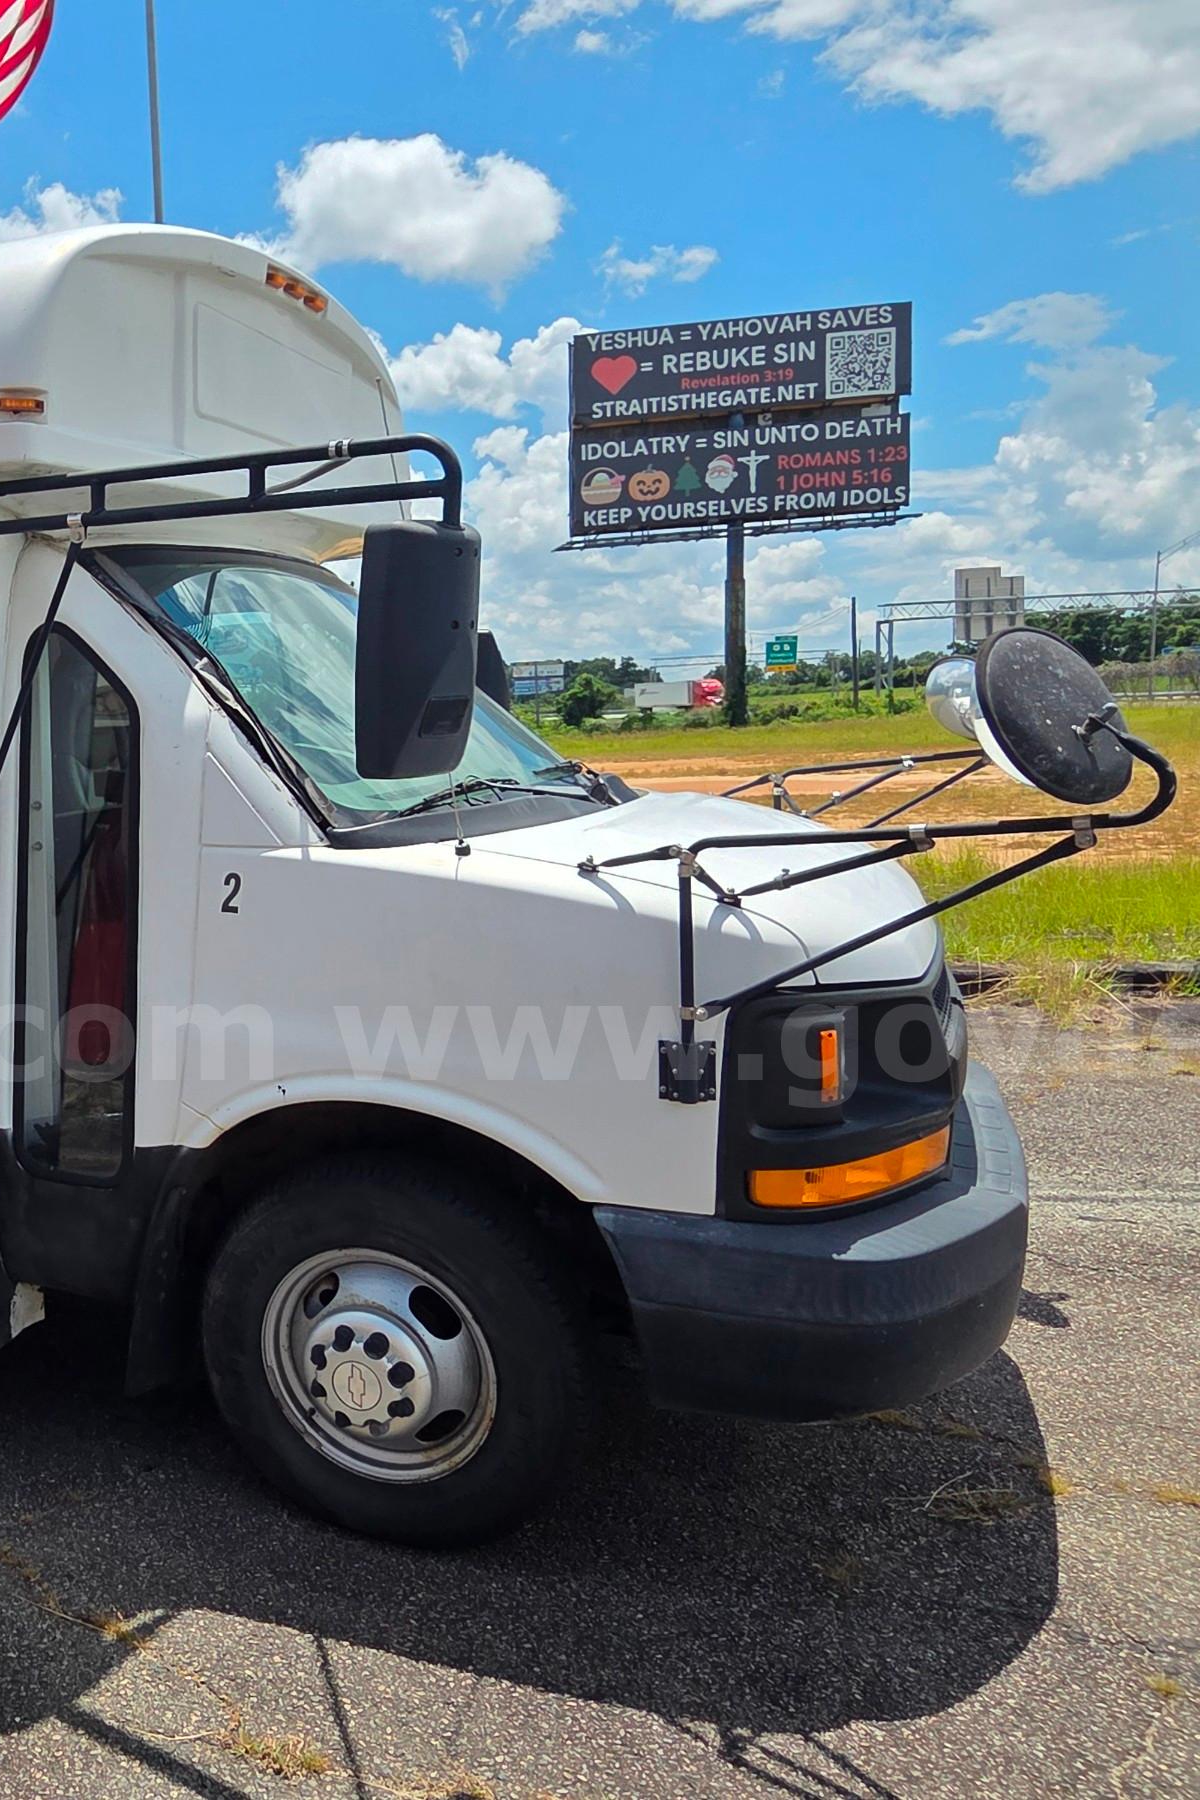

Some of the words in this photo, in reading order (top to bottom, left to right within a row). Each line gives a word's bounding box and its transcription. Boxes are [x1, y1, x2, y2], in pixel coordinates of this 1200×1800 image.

[587, 328, 674, 352] YESHUA
[680, 330, 692, 341] =
[698, 313, 811, 341] YAHOVAH
[818, 306, 892, 329] SAVES
[640, 362, 653, 372] =
[662, 345, 766, 374] REBUKE
[773, 340, 815, 364] SIN
[681, 371, 759, 389] Revelation
[763, 368, 794, 382] 3:19
[592, 382, 818, 419] STRAITISTHEGATE.NET
[581, 435, 690, 461] IDOLATRY
[696, 438, 708, 448] =
[713, 429, 748, 449] SIN
[755, 424, 819, 445] UNTO
[825, 416, 901, 439] DEATH
[777, 448, 861, 469] ROMANS
[867, 445, 908, 463] 1:23
[776, 475, 785, 490] 1
[790, 471, 845, 492] JOHN
[852, 467, 892, 485] 5:16
[583, 507, 632, 527] KEEP
[637, 496, 768, 522] YOURSELVES
[774, 491, 835, 511] FROM
[842, 486, 906, 506] IDOLS
[221, 872, 241, 914] 2
